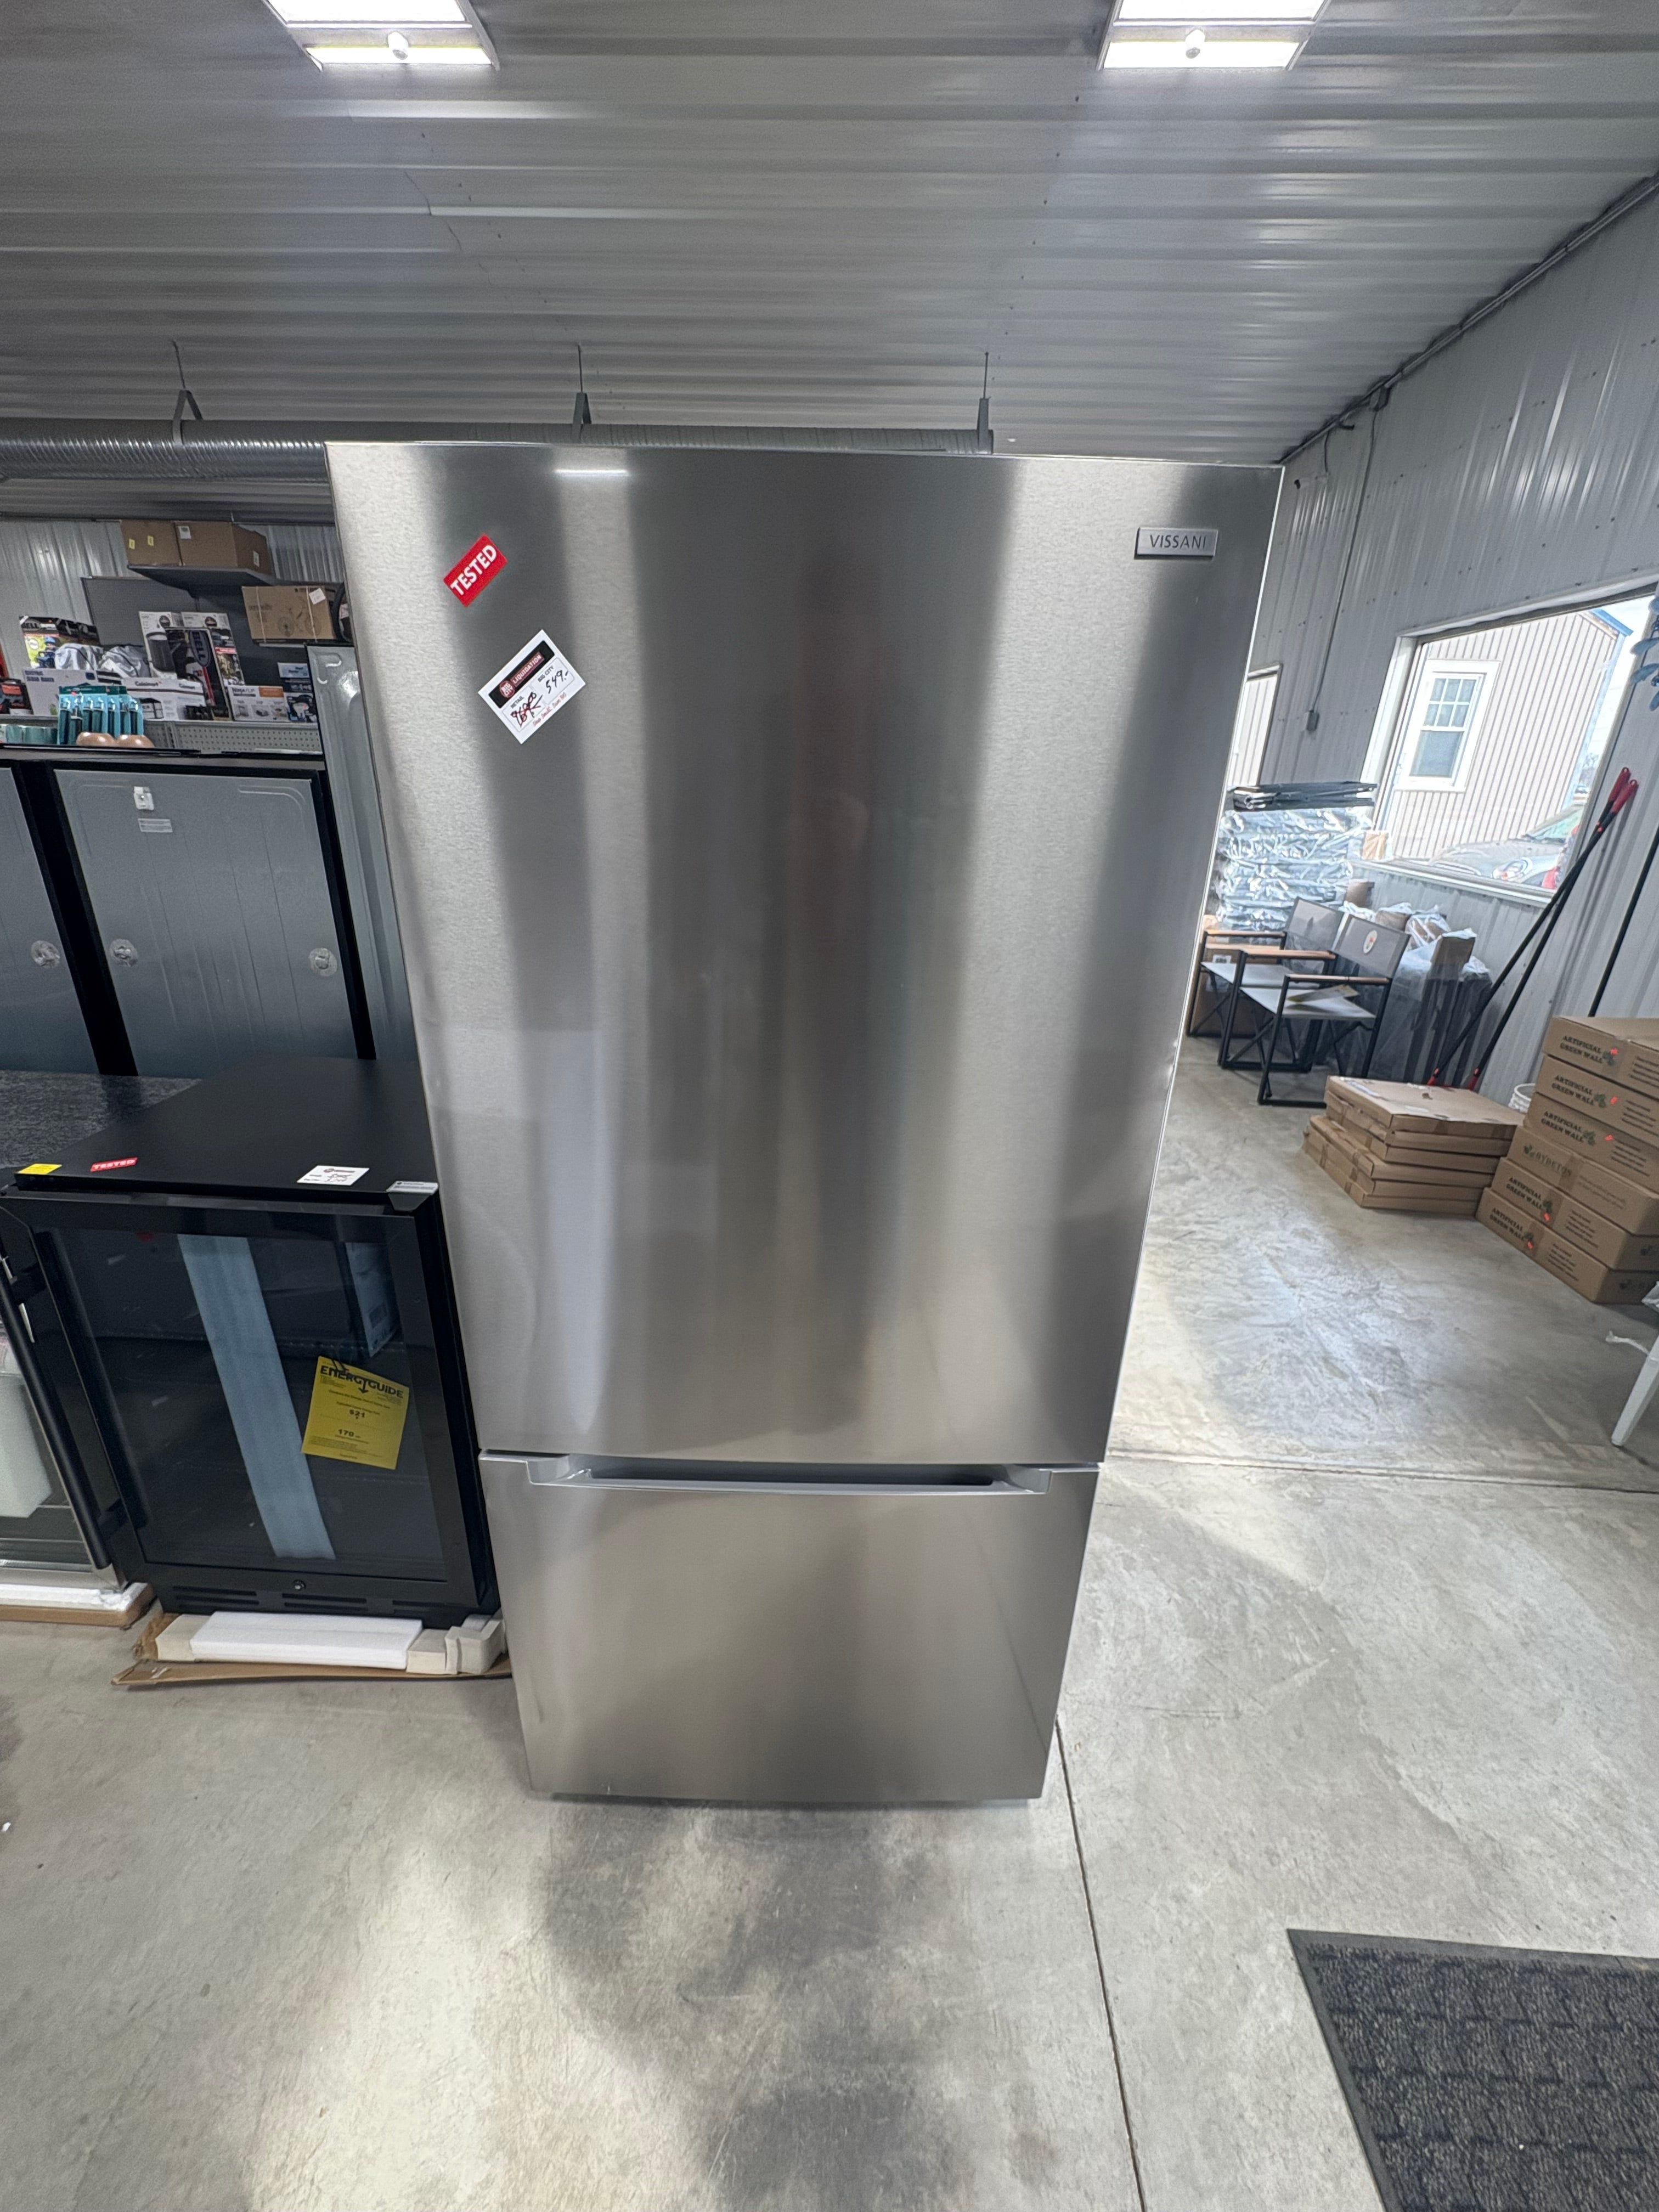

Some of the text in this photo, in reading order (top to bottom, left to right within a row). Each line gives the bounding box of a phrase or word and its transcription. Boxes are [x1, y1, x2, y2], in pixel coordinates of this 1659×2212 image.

[1149, 534, 1206, 549] VISSANI
[450, 544, 497, 596] TESTED
[512, 654, 542, 684] LIQUIDATION
[545, 665, 554, 676] CITY
[510, 696, 524, 709] RETAIL
[1560, 1042, 1603, 1064] GREEN WALL
[1563, 1035, 1602, 1054] ARTIFICIAL
[1551, 1082, 1594, 1106] GREEN WALL
[1554, 1075, 1593, 1095] ARTIFICIAL
[1541, 1118, 1584, 1143] GREEN WALL
[1544, 1111, 1582, 1132] ARTIFICIAL
[93, 1159, 136, 1170] TESTED
[320, 1365, 403, 1399] ENERGYGUIDE
[338, 1429, 354, 1437] 170
